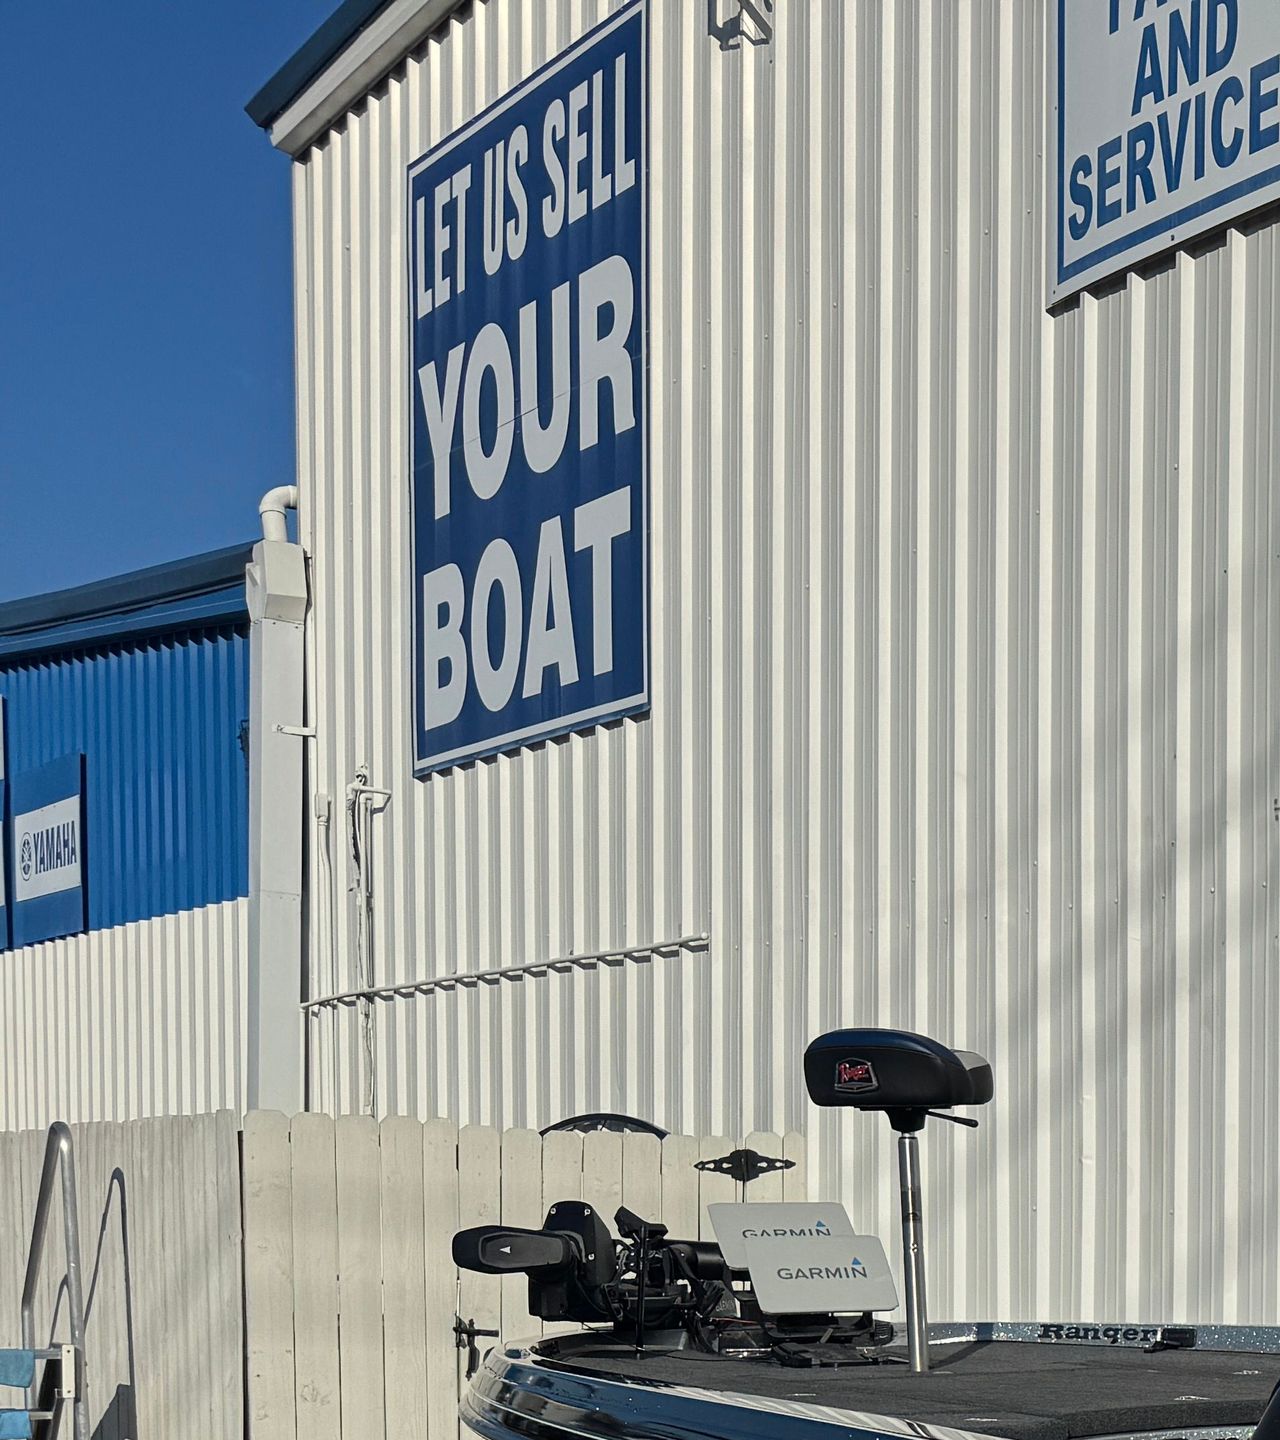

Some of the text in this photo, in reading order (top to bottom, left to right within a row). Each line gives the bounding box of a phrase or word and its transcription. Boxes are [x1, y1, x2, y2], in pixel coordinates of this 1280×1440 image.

[1131, 0, 1239, 117] AND
[415, 52, 636, 319] LET US SELL
[417, 254, 636, 521] YOUR
[423, 485, 631, 731] BOAT
[33, 820, 77, 875] YAMAHA
[777, 1266, 868, 1280] GARMIN
[1038, 1324, 1159, 1344] Ranger
